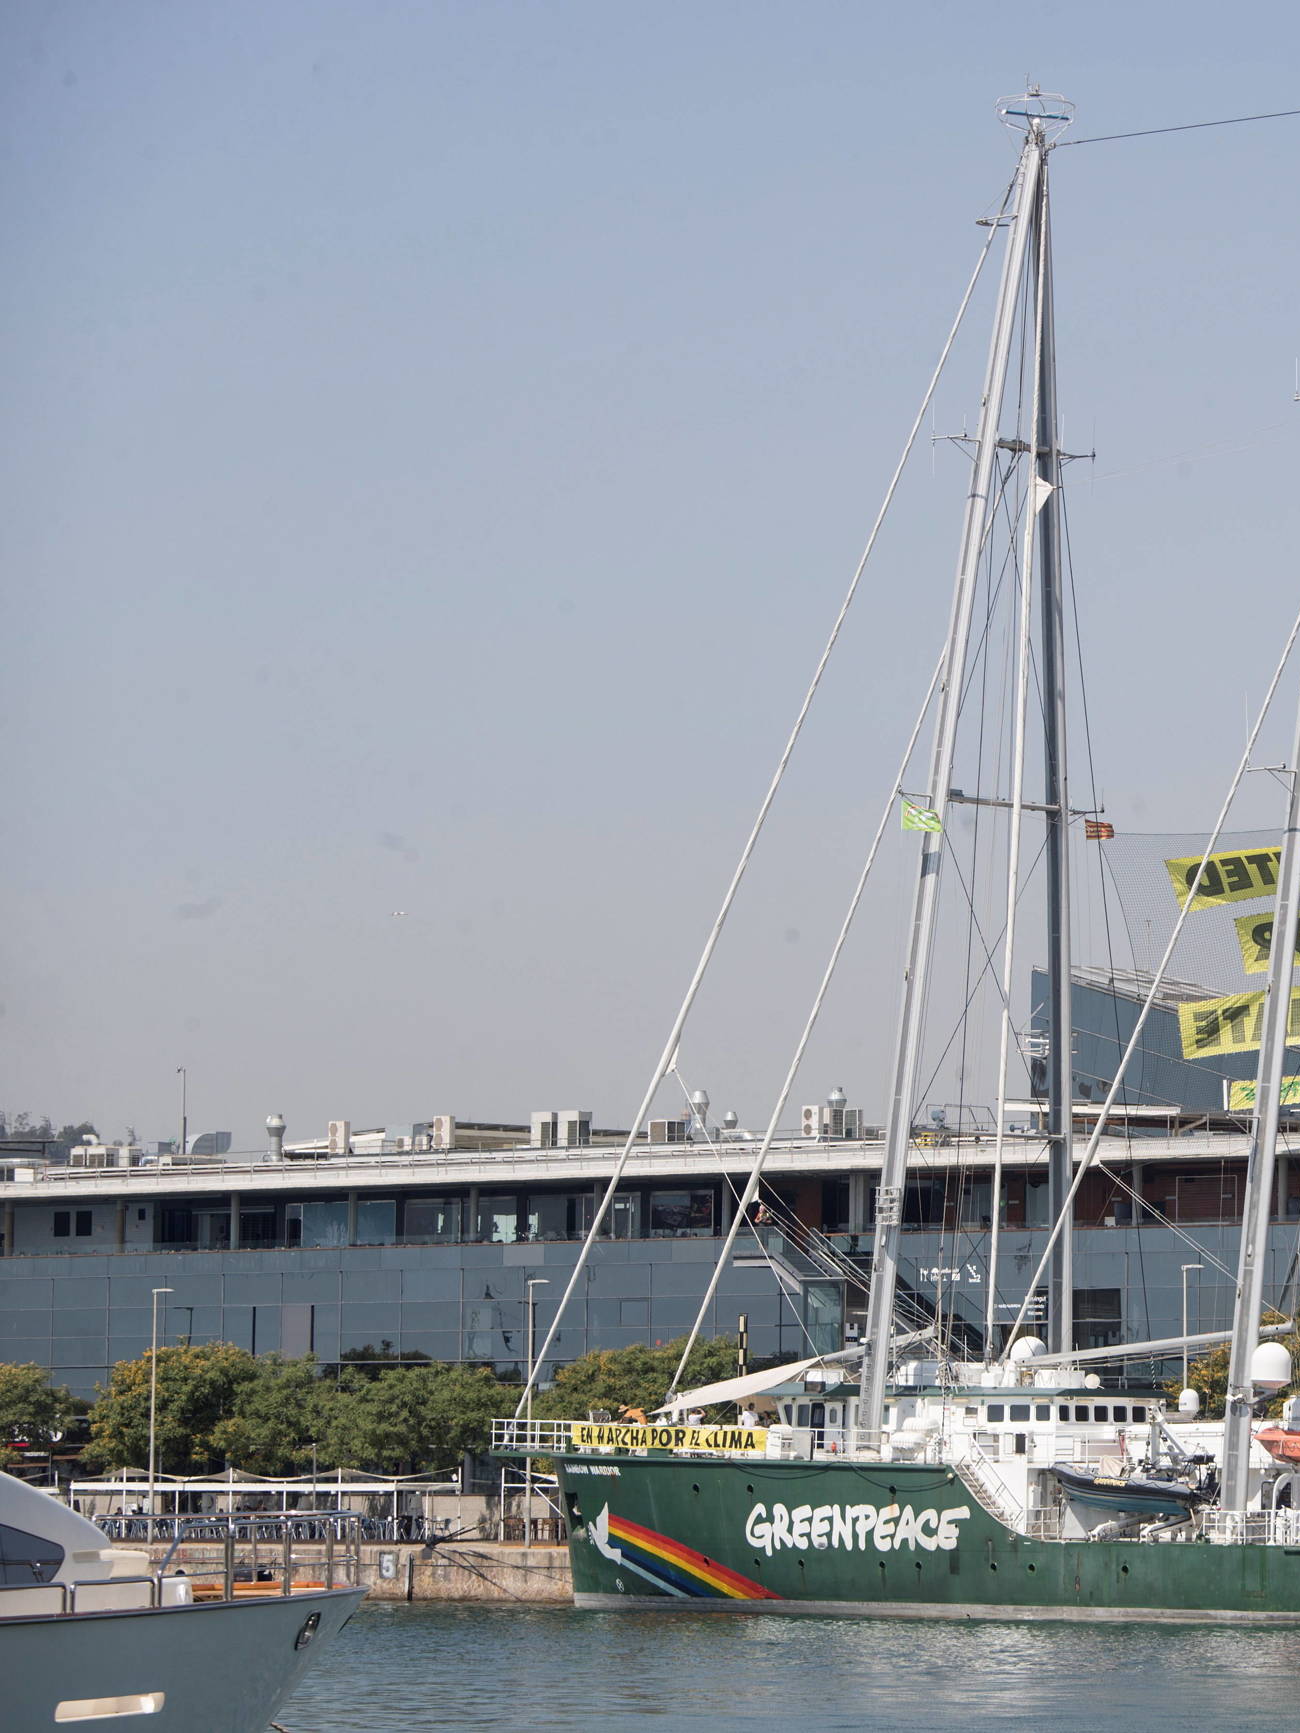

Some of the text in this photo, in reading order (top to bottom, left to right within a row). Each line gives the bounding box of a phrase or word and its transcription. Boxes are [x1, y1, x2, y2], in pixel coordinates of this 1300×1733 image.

[580, 1427, 592, 1444] EN
[651, 1428, 686, 1447] POR
[705, 1431, 756, 1449] CLIMA
[746, 1503, 970, 1556] GREENPEACE
[382, 1553, 396, 1577] 5
